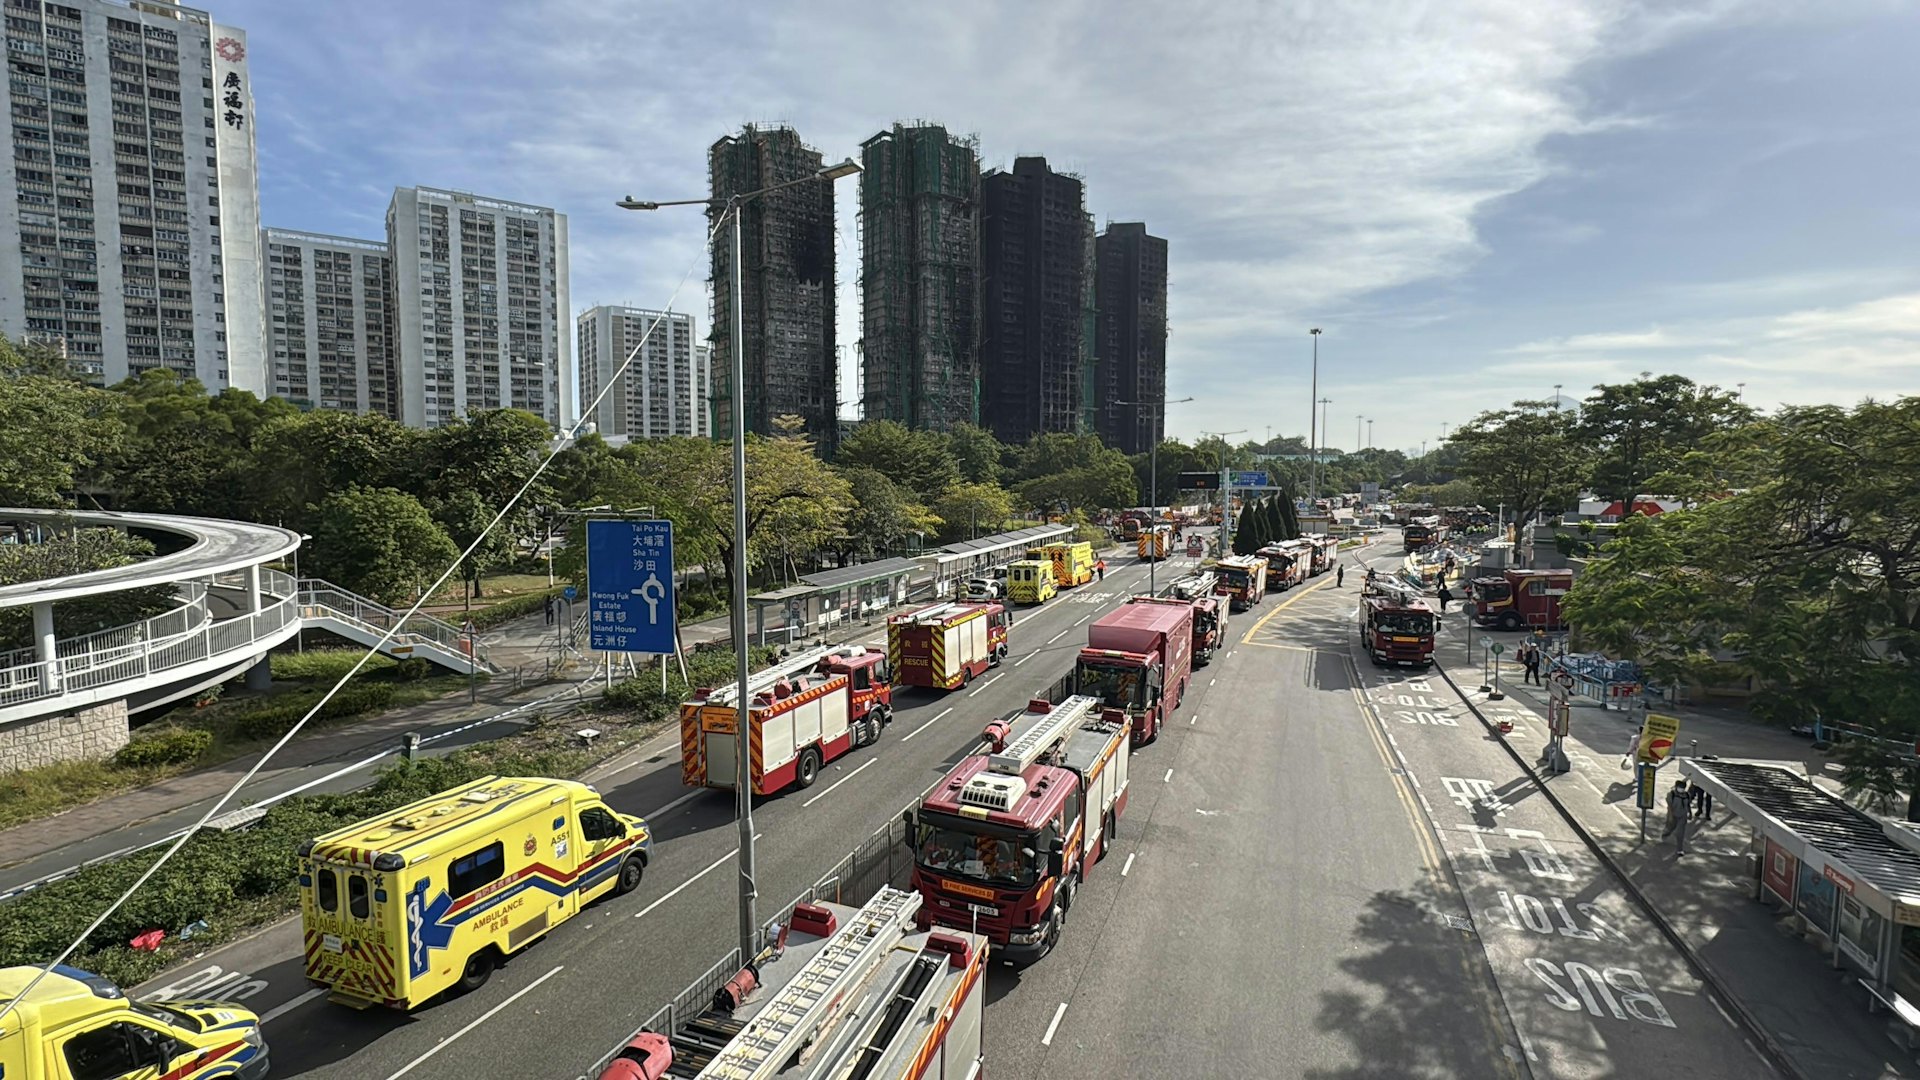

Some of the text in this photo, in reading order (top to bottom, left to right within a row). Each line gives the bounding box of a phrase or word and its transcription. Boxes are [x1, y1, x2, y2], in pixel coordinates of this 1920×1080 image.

[634, 559, 656, 570] 沙田
[592, 592, 615, 600] Kwong
[593, 625, 613, 633] Island
[594, 635, 628, 647] 元洲仔
[904, 658, 928, 666] RESCUE
[1393, 710, 1459, 727] BUS
[551, 831, 570, 846] A551
[1456, 823, 1575, 882] 巴士
[949, 882, 961, 890] FIRE
[962, 886, 985, 896] SERVICES
[473, 898, 524, 932] AMBULANCE
[1484, 890, 1631, 944] STOP
[319, 918, 373, 942] AMBULANCE
[324, 954, 372, 972] KEEP CLEAR
[1523, 958, 1678, 1028] BUS
